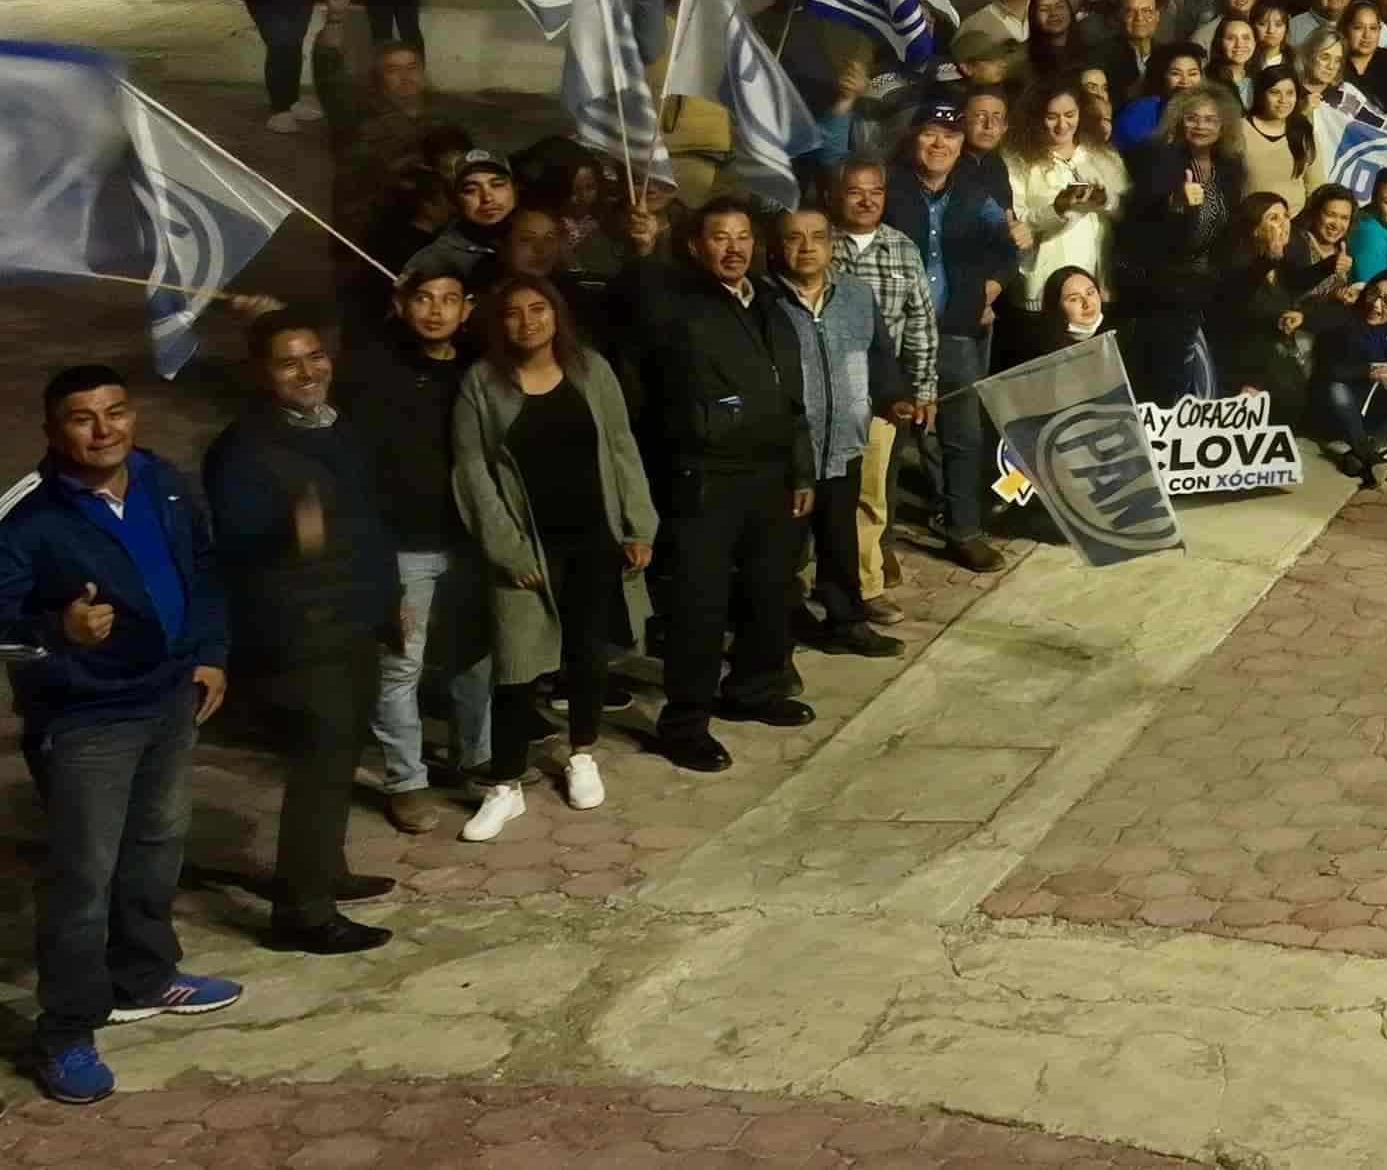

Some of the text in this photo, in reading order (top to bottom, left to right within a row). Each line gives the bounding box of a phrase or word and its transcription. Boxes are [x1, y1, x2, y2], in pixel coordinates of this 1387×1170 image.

[1176, 397, 1266, 432] CORAZÓN
[1055, 415, 1174, 531] PAN
[1168, 469, 1298, 493] CON XÓCHITL
